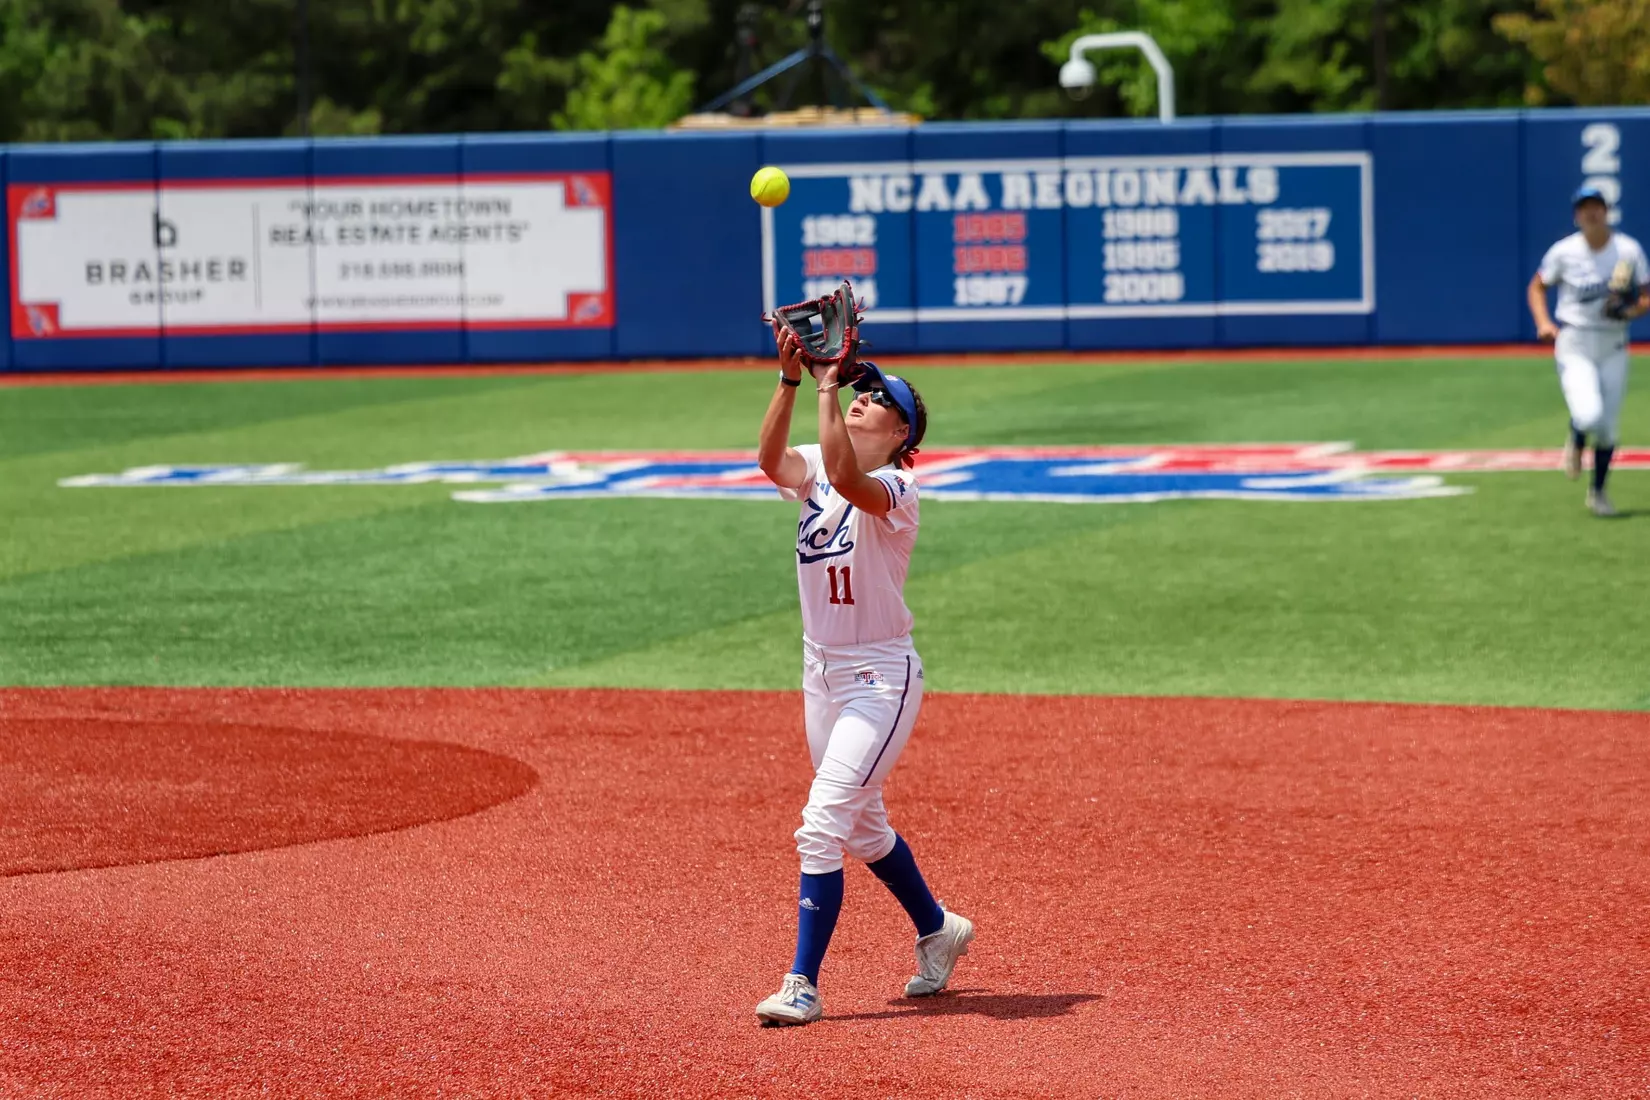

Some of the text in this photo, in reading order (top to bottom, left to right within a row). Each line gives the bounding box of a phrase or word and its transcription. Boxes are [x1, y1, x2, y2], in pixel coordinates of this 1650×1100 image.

[850, 166, 1280, 213] NCAA REGIONALS
[368, 196, 513, 218] HOMETOWN
[268, 222, 331, 248] REAL
[335, 222, 424, 246] ESTATE
[1256, 207, 1332, 241] 2017
[85, 258, 248, 286] BRASHER
[1256, 240, 1335, 273] 2019
[826, 565, 855, 605] 11
